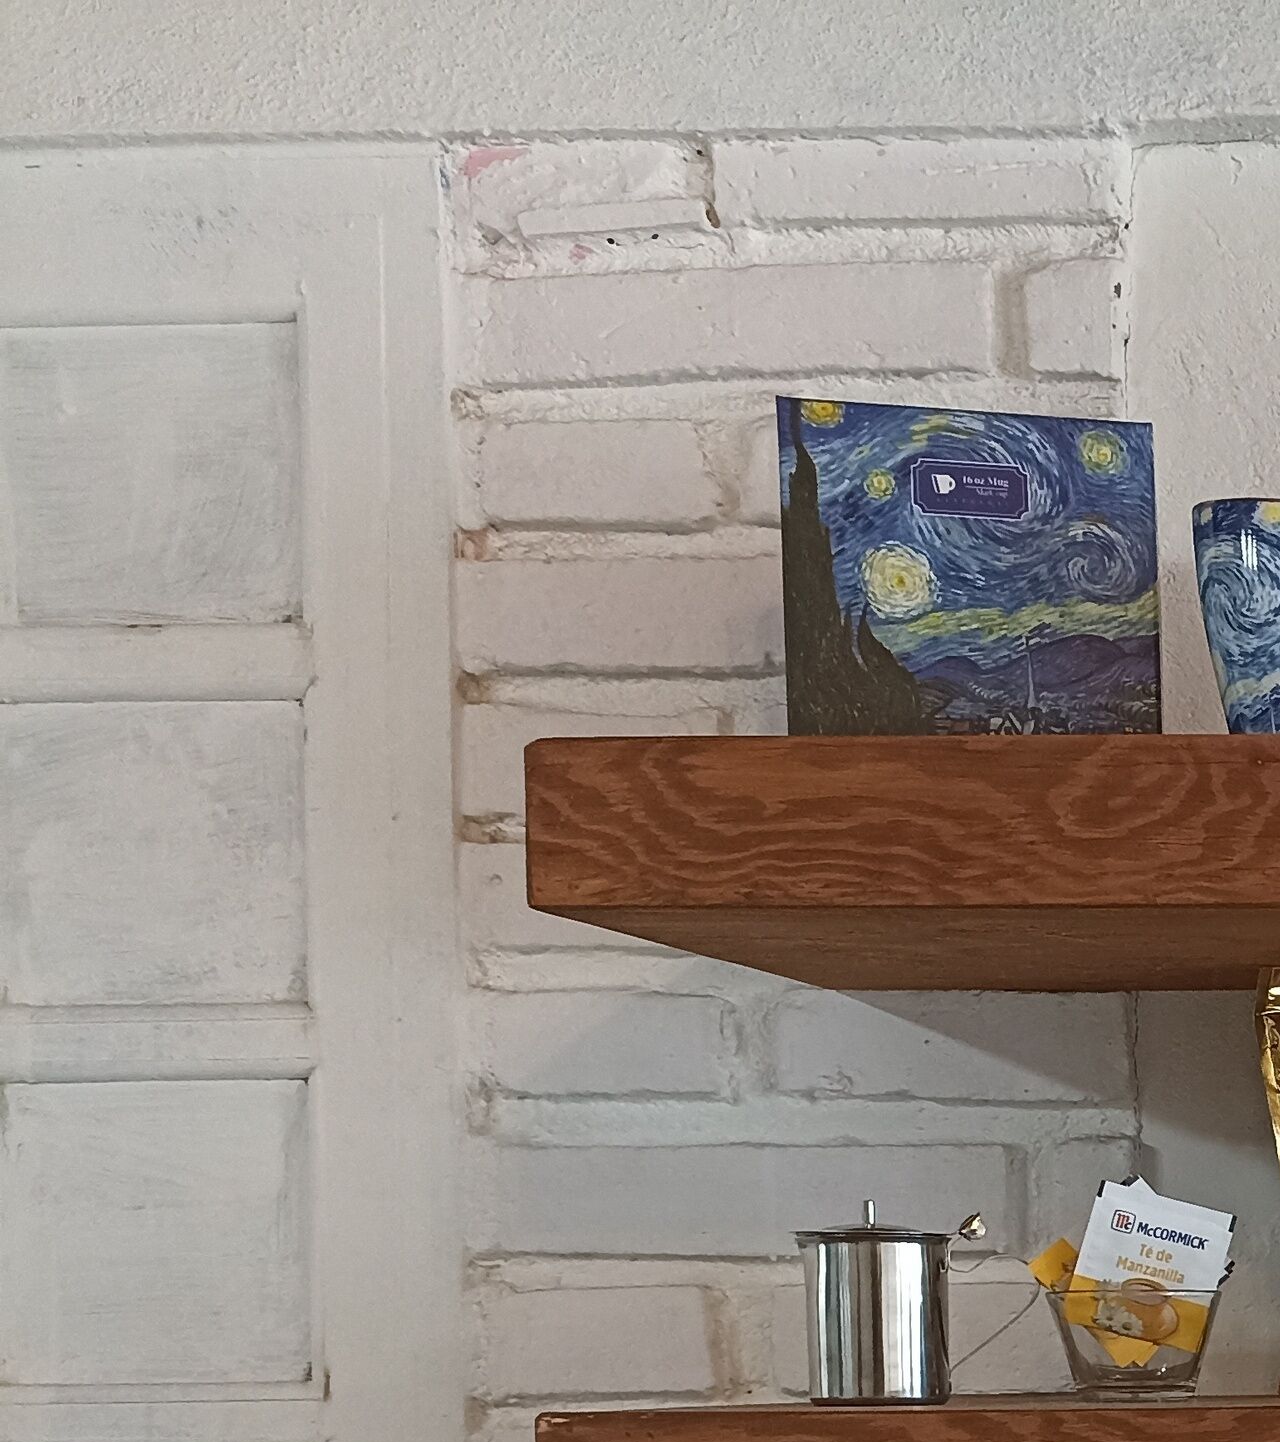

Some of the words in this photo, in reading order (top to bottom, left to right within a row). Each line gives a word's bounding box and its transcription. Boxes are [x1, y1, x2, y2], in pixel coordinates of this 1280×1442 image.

[988, 477, 1009, 488] Mug
[1136, 1221, 1209, 1250] McCORMICK
[1139, 1243, 1153, 1258] Té
[1156, 1249, 1173, 1263] de
[1115, 1255, 1185, 1284] Manzanilla
